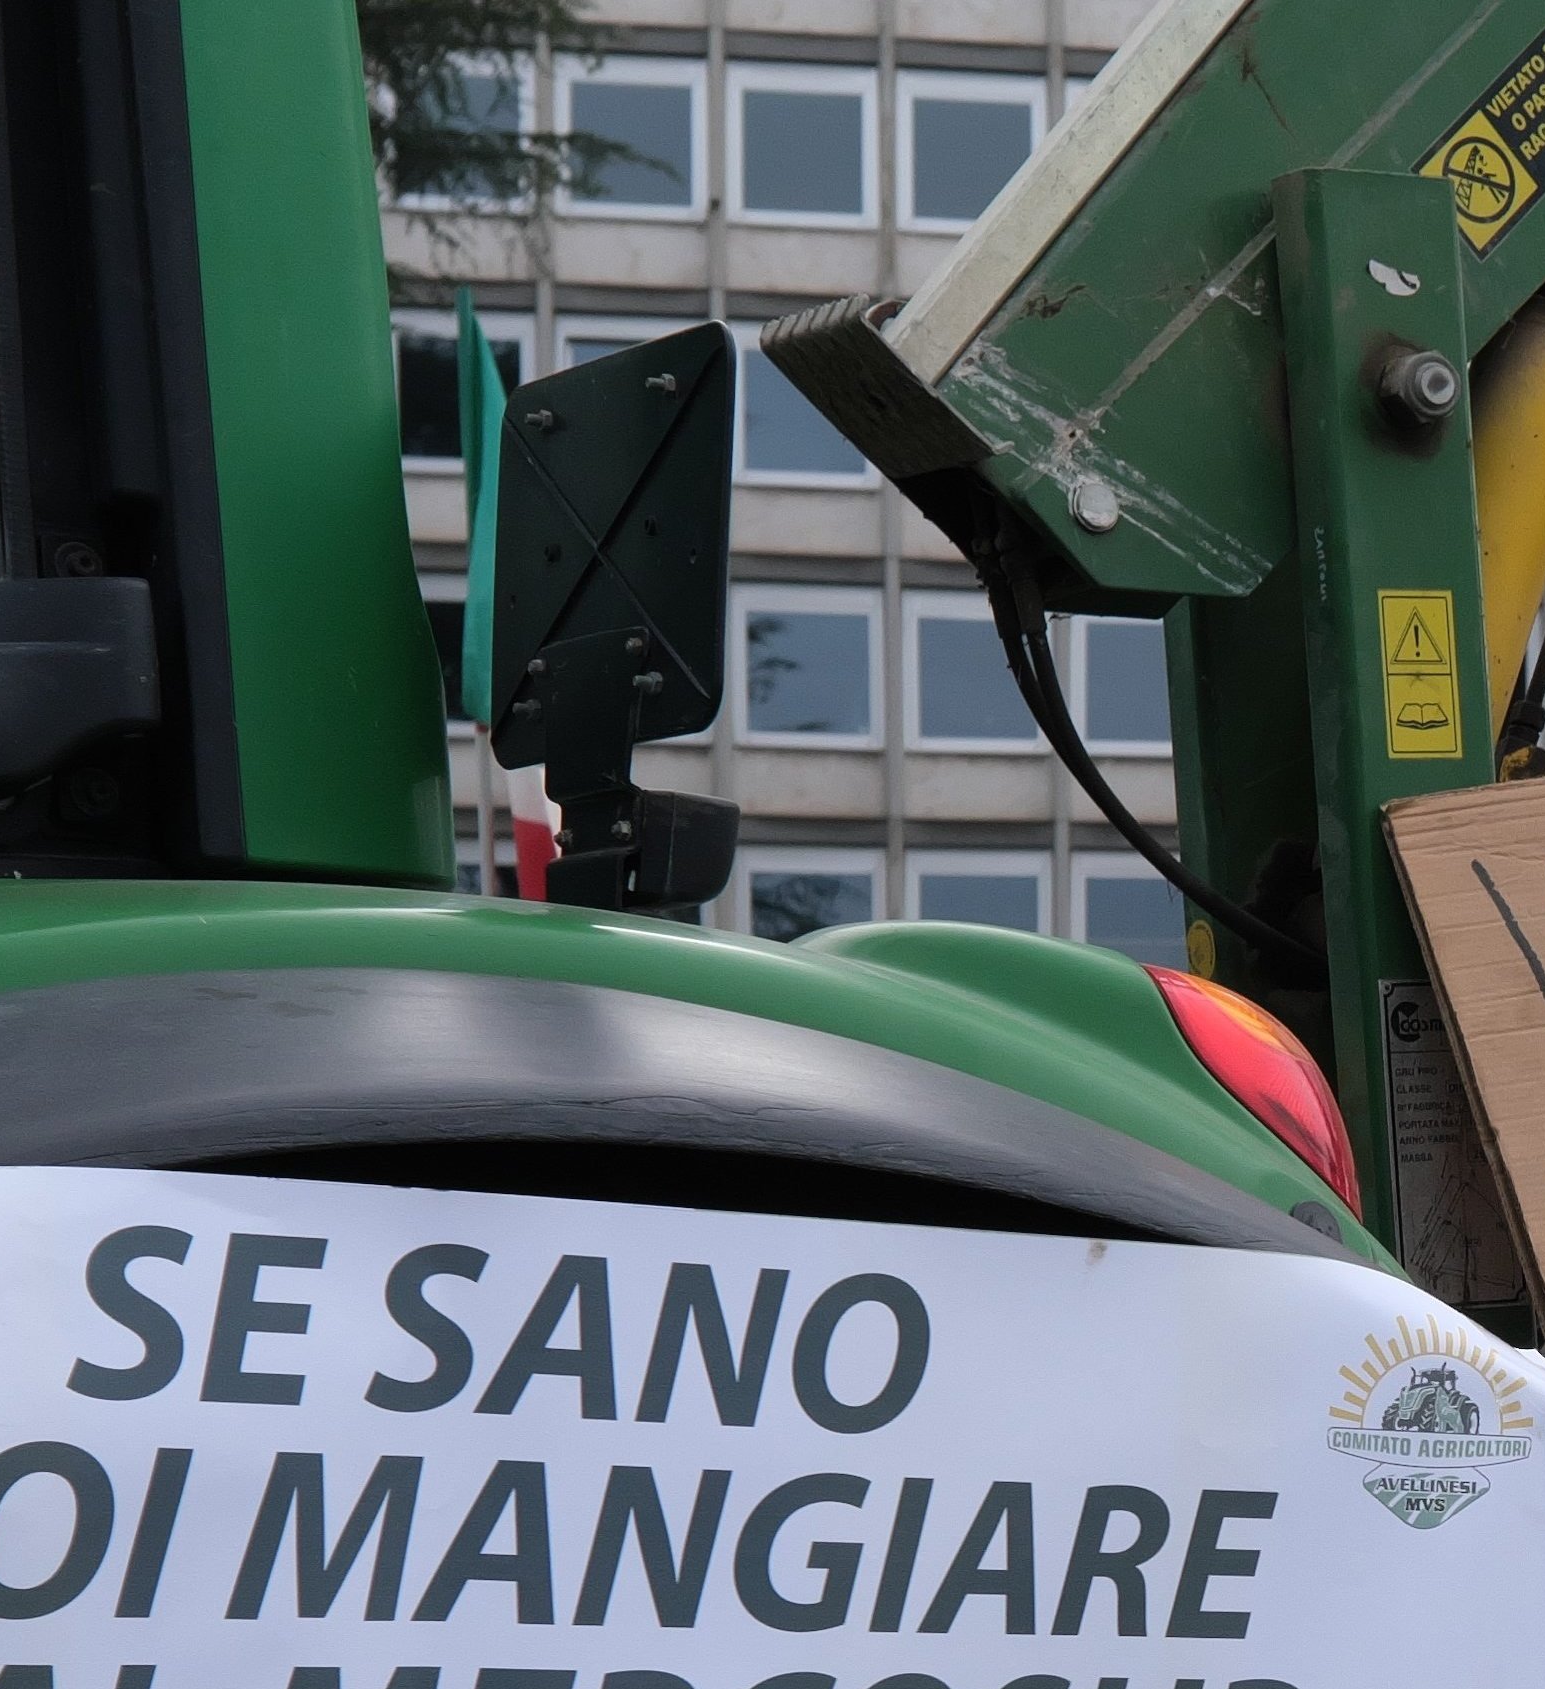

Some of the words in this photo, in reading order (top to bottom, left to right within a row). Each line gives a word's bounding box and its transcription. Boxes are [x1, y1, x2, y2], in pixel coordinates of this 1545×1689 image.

[1486, 54, 1545, 118] VIETATO
[1511, 113, 1527, 131] O
[67, 1226, 328, 1405] SE
[365, 1244, 930, 1434] SANO
[1332, 1431, 1411, 1457] COMITATO
[1417, 1439, 1528, 1459] AGRICOLTORI
[1376, 1477, 1477, 1495] AVELLINESI
[1405, 1498, 1446, 1512] MVS
[225, 1453, 1278, 1639] MANGIARE
